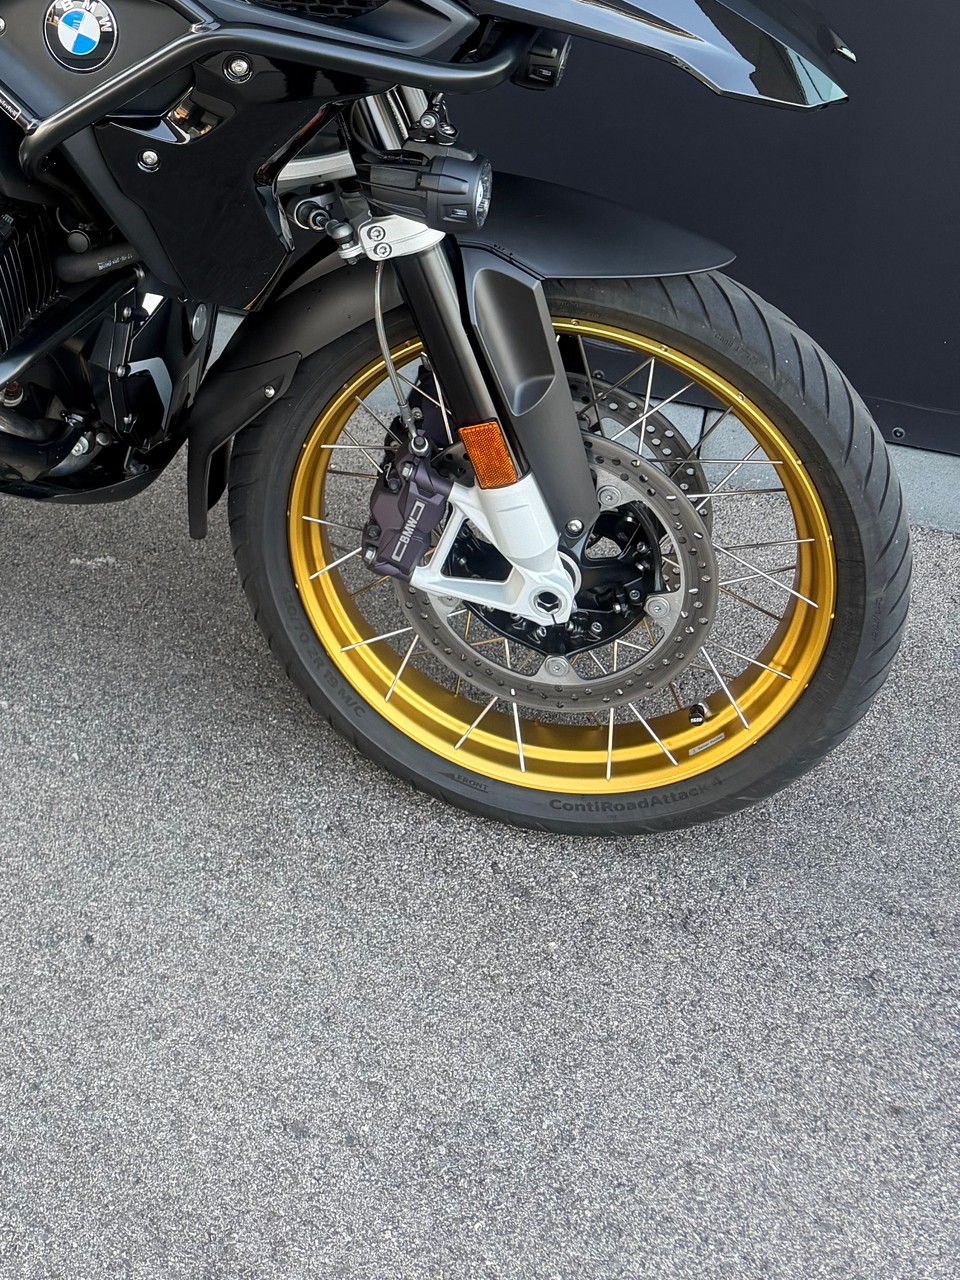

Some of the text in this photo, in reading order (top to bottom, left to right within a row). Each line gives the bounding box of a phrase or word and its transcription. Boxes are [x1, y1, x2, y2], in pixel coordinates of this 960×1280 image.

[399, 516, 418, 544] BMW
[307, 648, 325, 670] ZR
[323, 668, 338, 688] 19
[457, 774, 489, 791] FRONT
[549, 775, 724, 813] ContiRoadAttack 4
